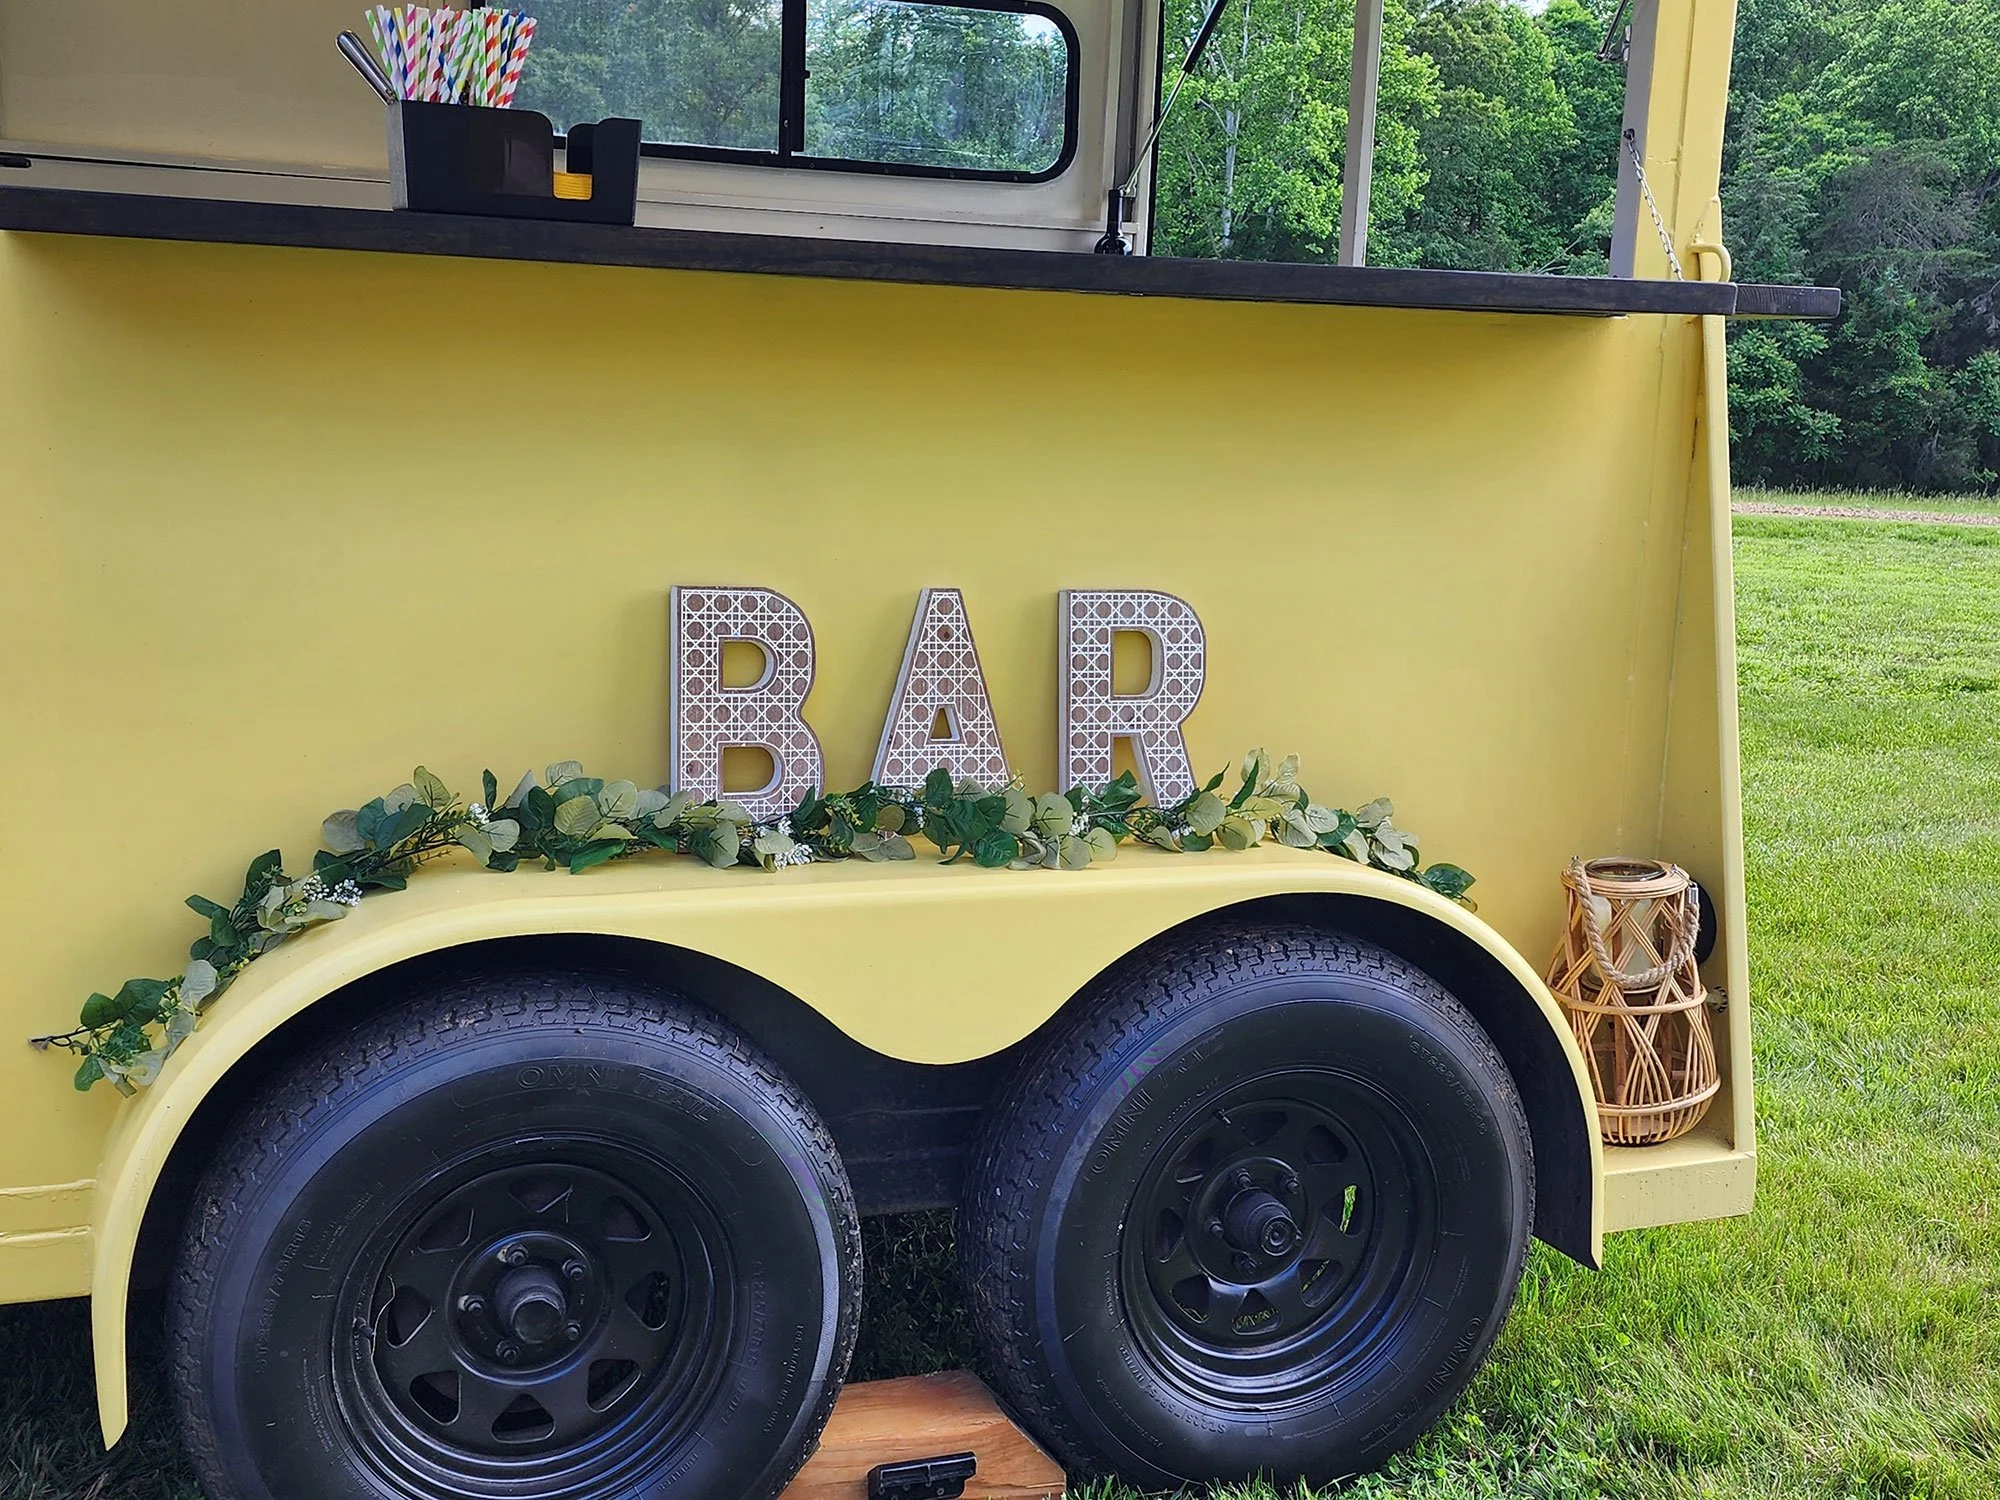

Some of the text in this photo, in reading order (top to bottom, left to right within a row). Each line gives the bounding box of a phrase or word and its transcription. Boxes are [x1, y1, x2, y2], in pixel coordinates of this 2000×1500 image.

[670, 585, 1206, 822] BAR
[517, 1063, 624, 1090] OMNI
[1090, 1087, 1154, 1175] OMNI
